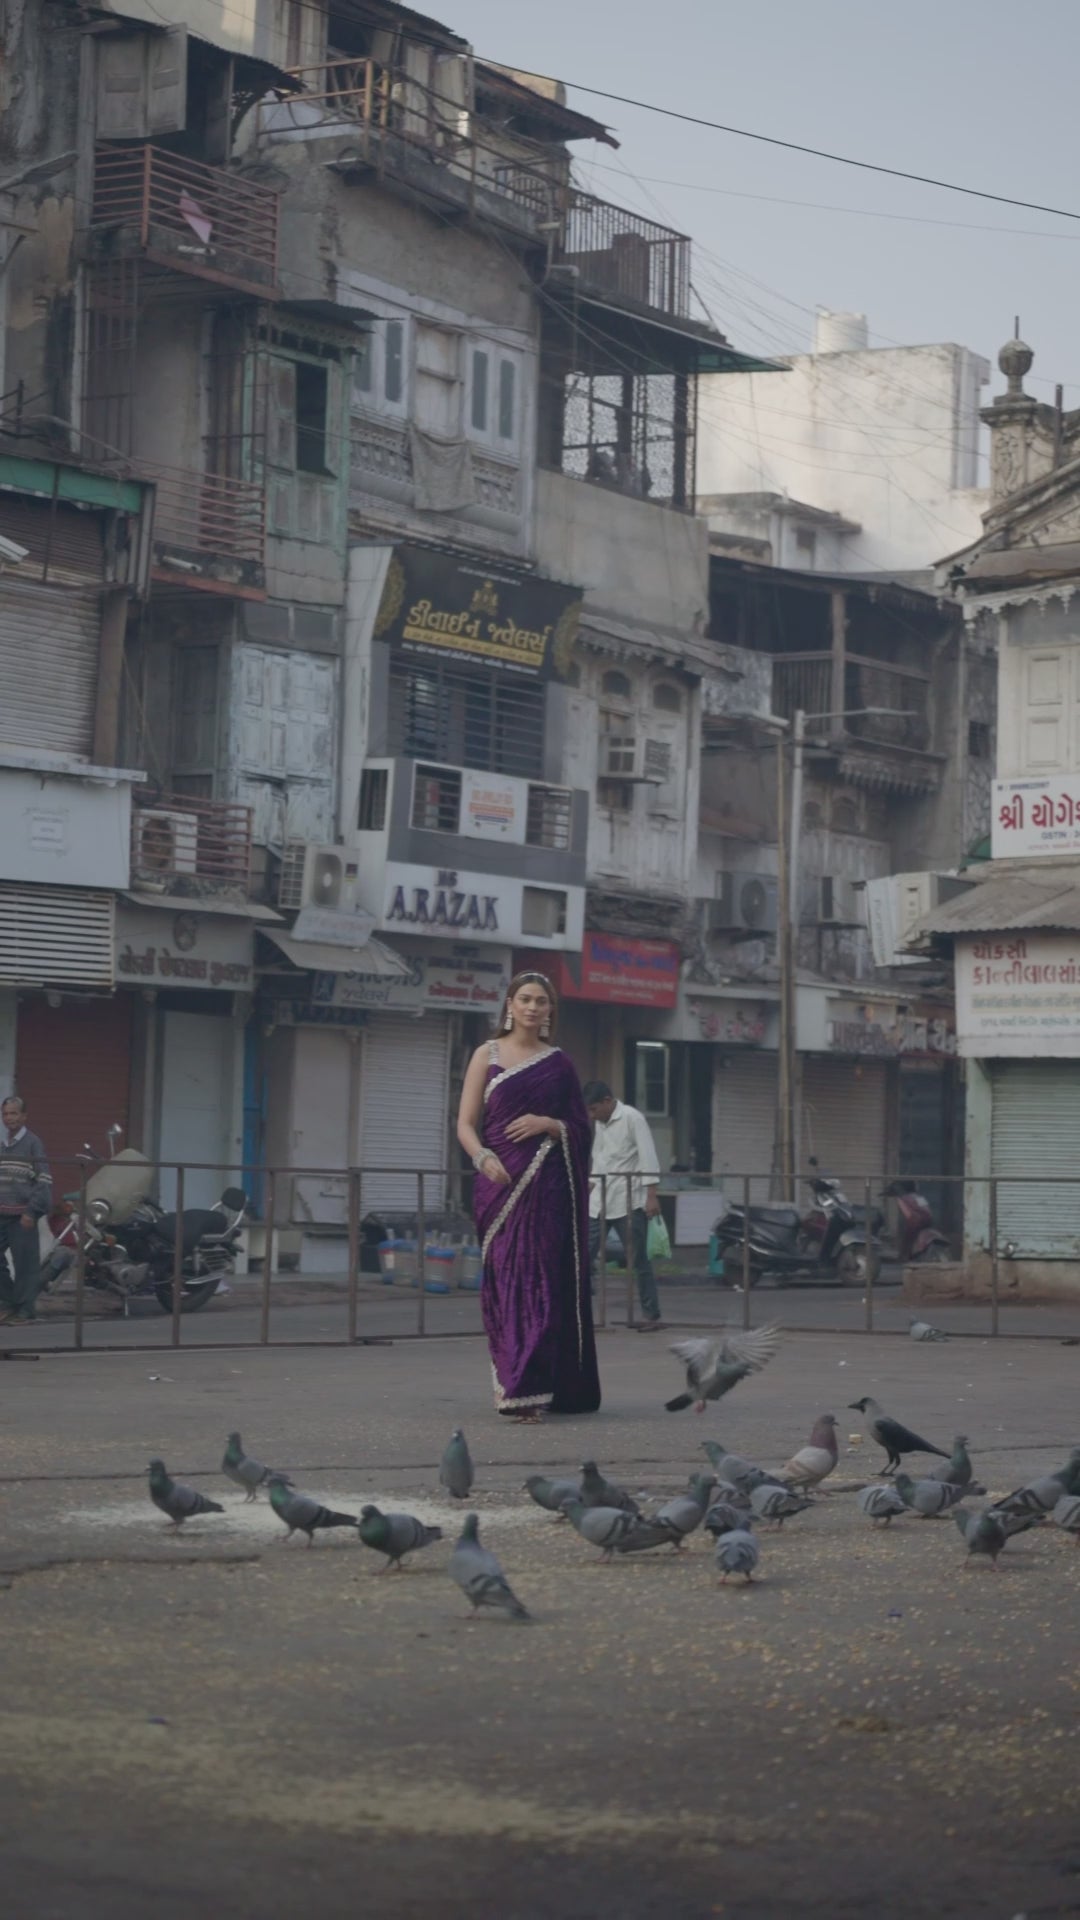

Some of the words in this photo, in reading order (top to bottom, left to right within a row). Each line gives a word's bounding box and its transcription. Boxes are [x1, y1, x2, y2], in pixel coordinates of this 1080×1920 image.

[998, 793, 1024, 830] શ્રી
[386, 885, 499, 931] A.RAZAK
[973, 939, 1027, 960] ચોકસી
